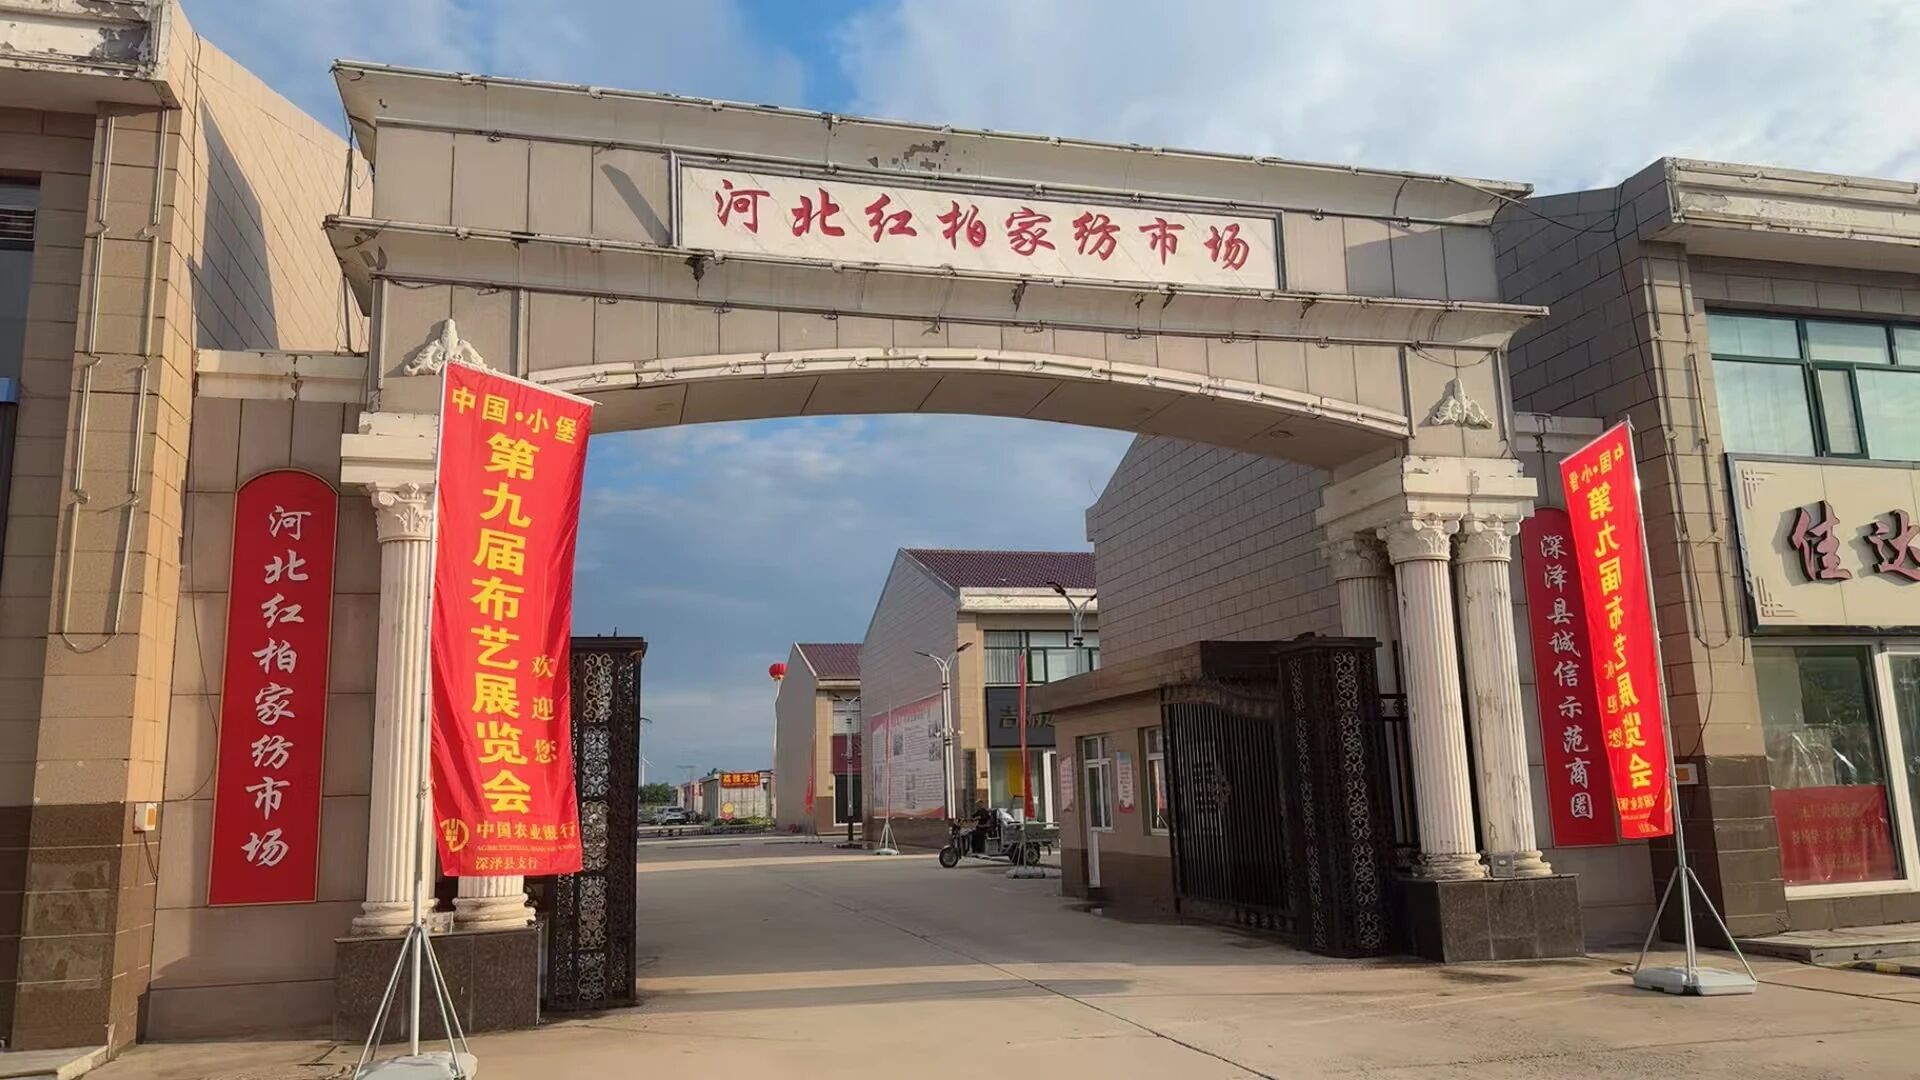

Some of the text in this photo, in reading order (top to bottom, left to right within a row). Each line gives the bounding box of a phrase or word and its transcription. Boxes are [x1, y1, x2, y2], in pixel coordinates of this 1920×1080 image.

[714, 179, 1249, 271] 河北红柏家纺市场
[471, 431, 541, 815] 第九届布艺展览会
[240, 505, 311, 868] 河北红柏家纺市场
[531, 653, 557, 765] 欢迎您
[476, 819, 577, 841] 中国农业银行
